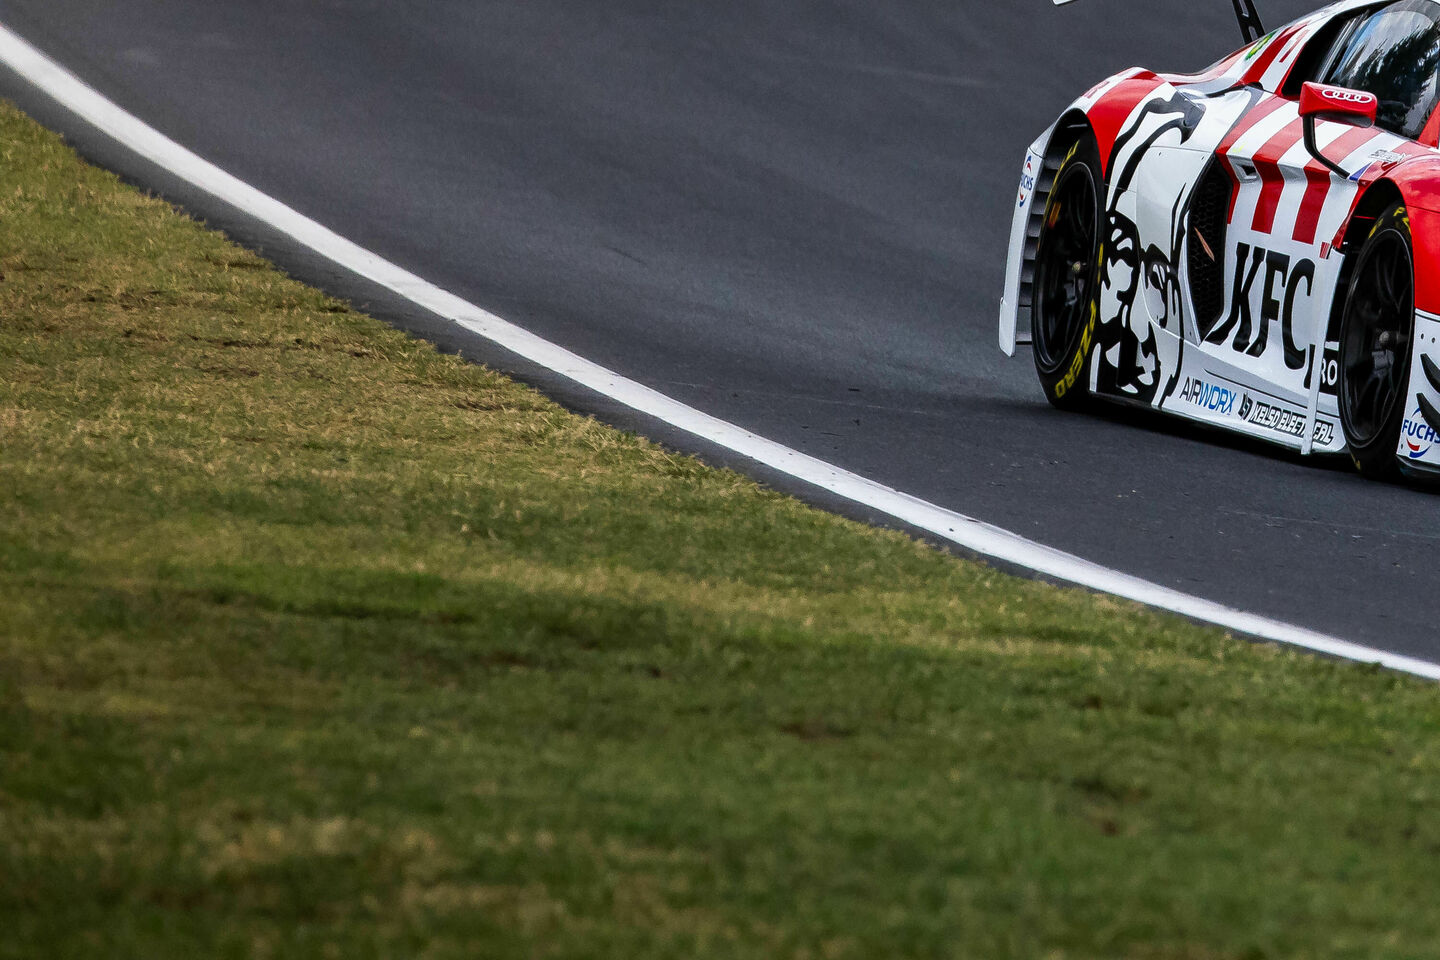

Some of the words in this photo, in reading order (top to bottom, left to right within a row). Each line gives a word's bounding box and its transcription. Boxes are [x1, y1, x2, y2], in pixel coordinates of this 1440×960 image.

[1204, 241, 1316, 370] KFC
[1179, 375, 1236, 414] AIRWORX
[1250, 404, 1281, 428] KELSO
